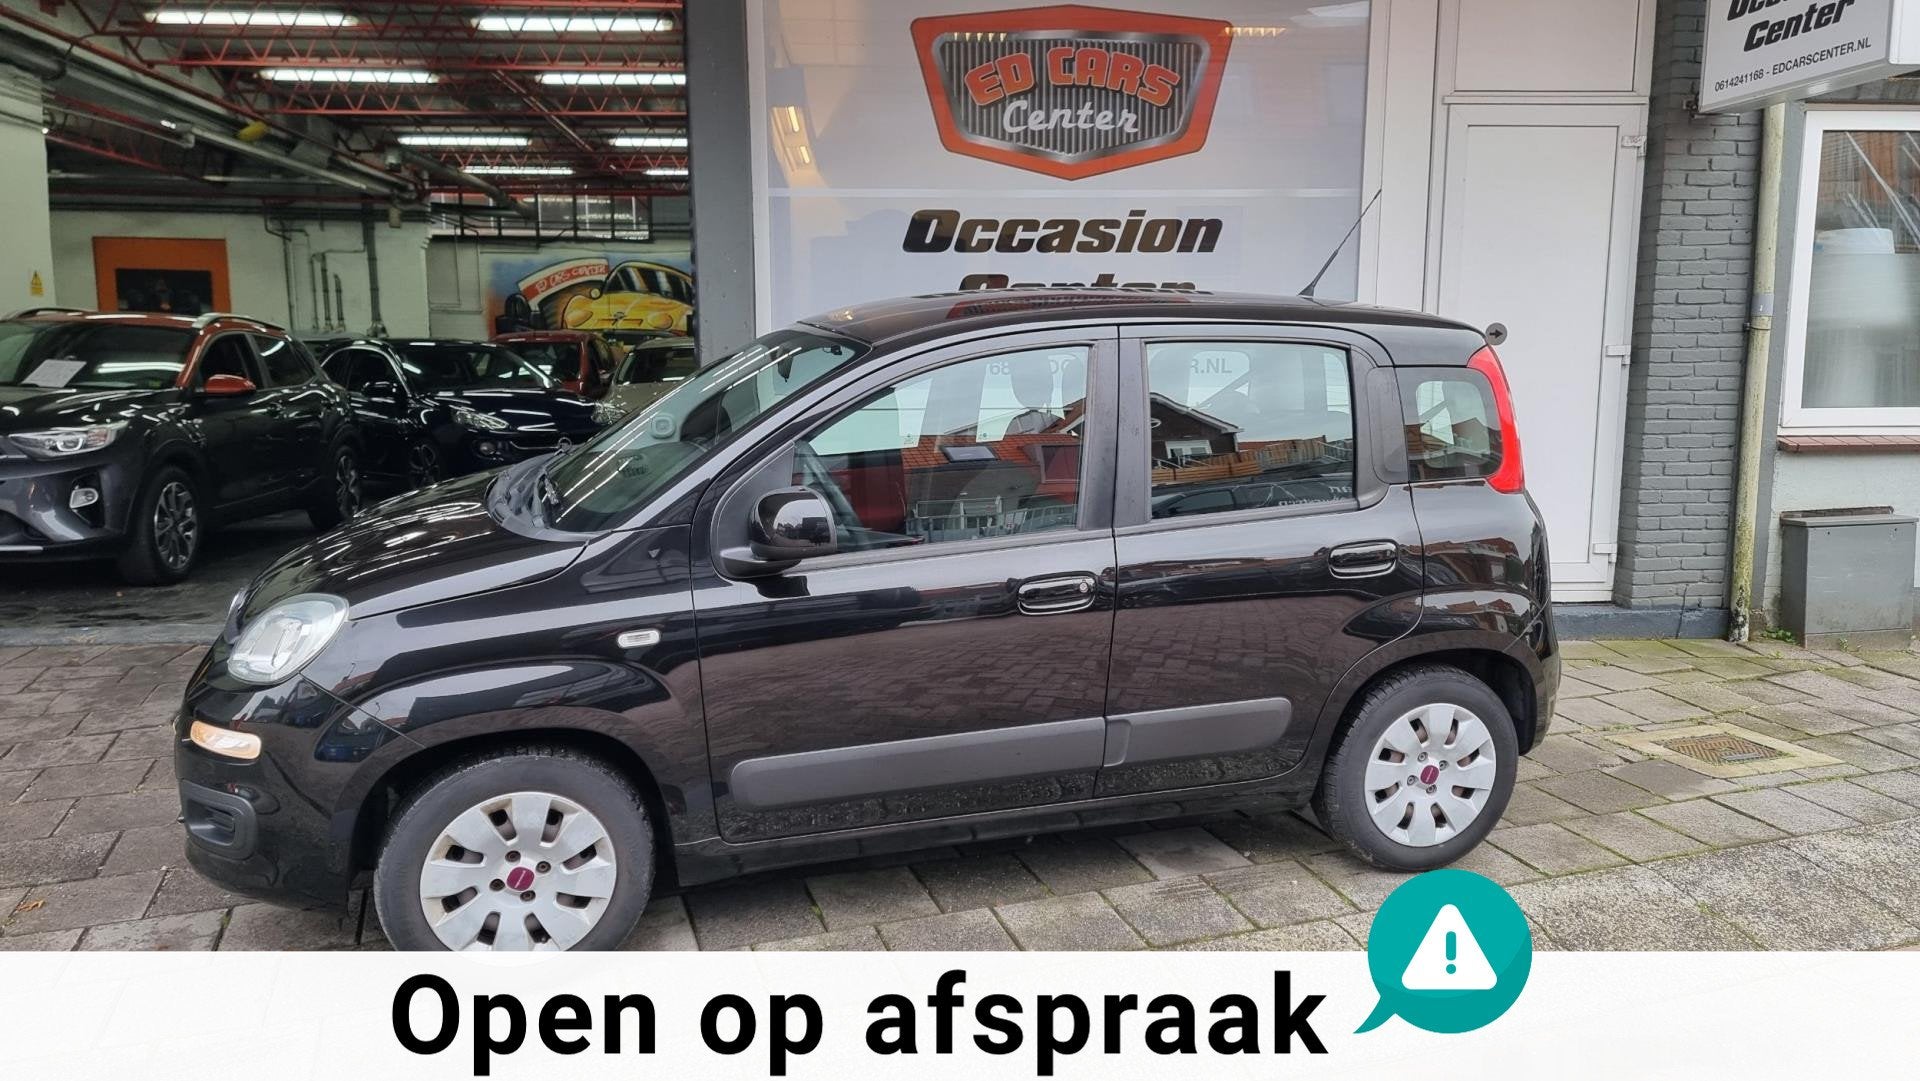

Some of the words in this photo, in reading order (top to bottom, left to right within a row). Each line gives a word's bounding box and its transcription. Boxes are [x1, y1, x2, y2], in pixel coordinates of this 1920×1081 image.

[1743, 0, 1855, 51] Center
[964, 52, 1036, 106] ED
[1047, 47, 1181, 107] CARS
[1714, 67, 1765, 92] 0614241168
[1772, 37, 1872, 76] EDCARSCENTER.NL
[1003, 99, 1139, 133] Center
[902, 208, 1224, 253] Occasion
